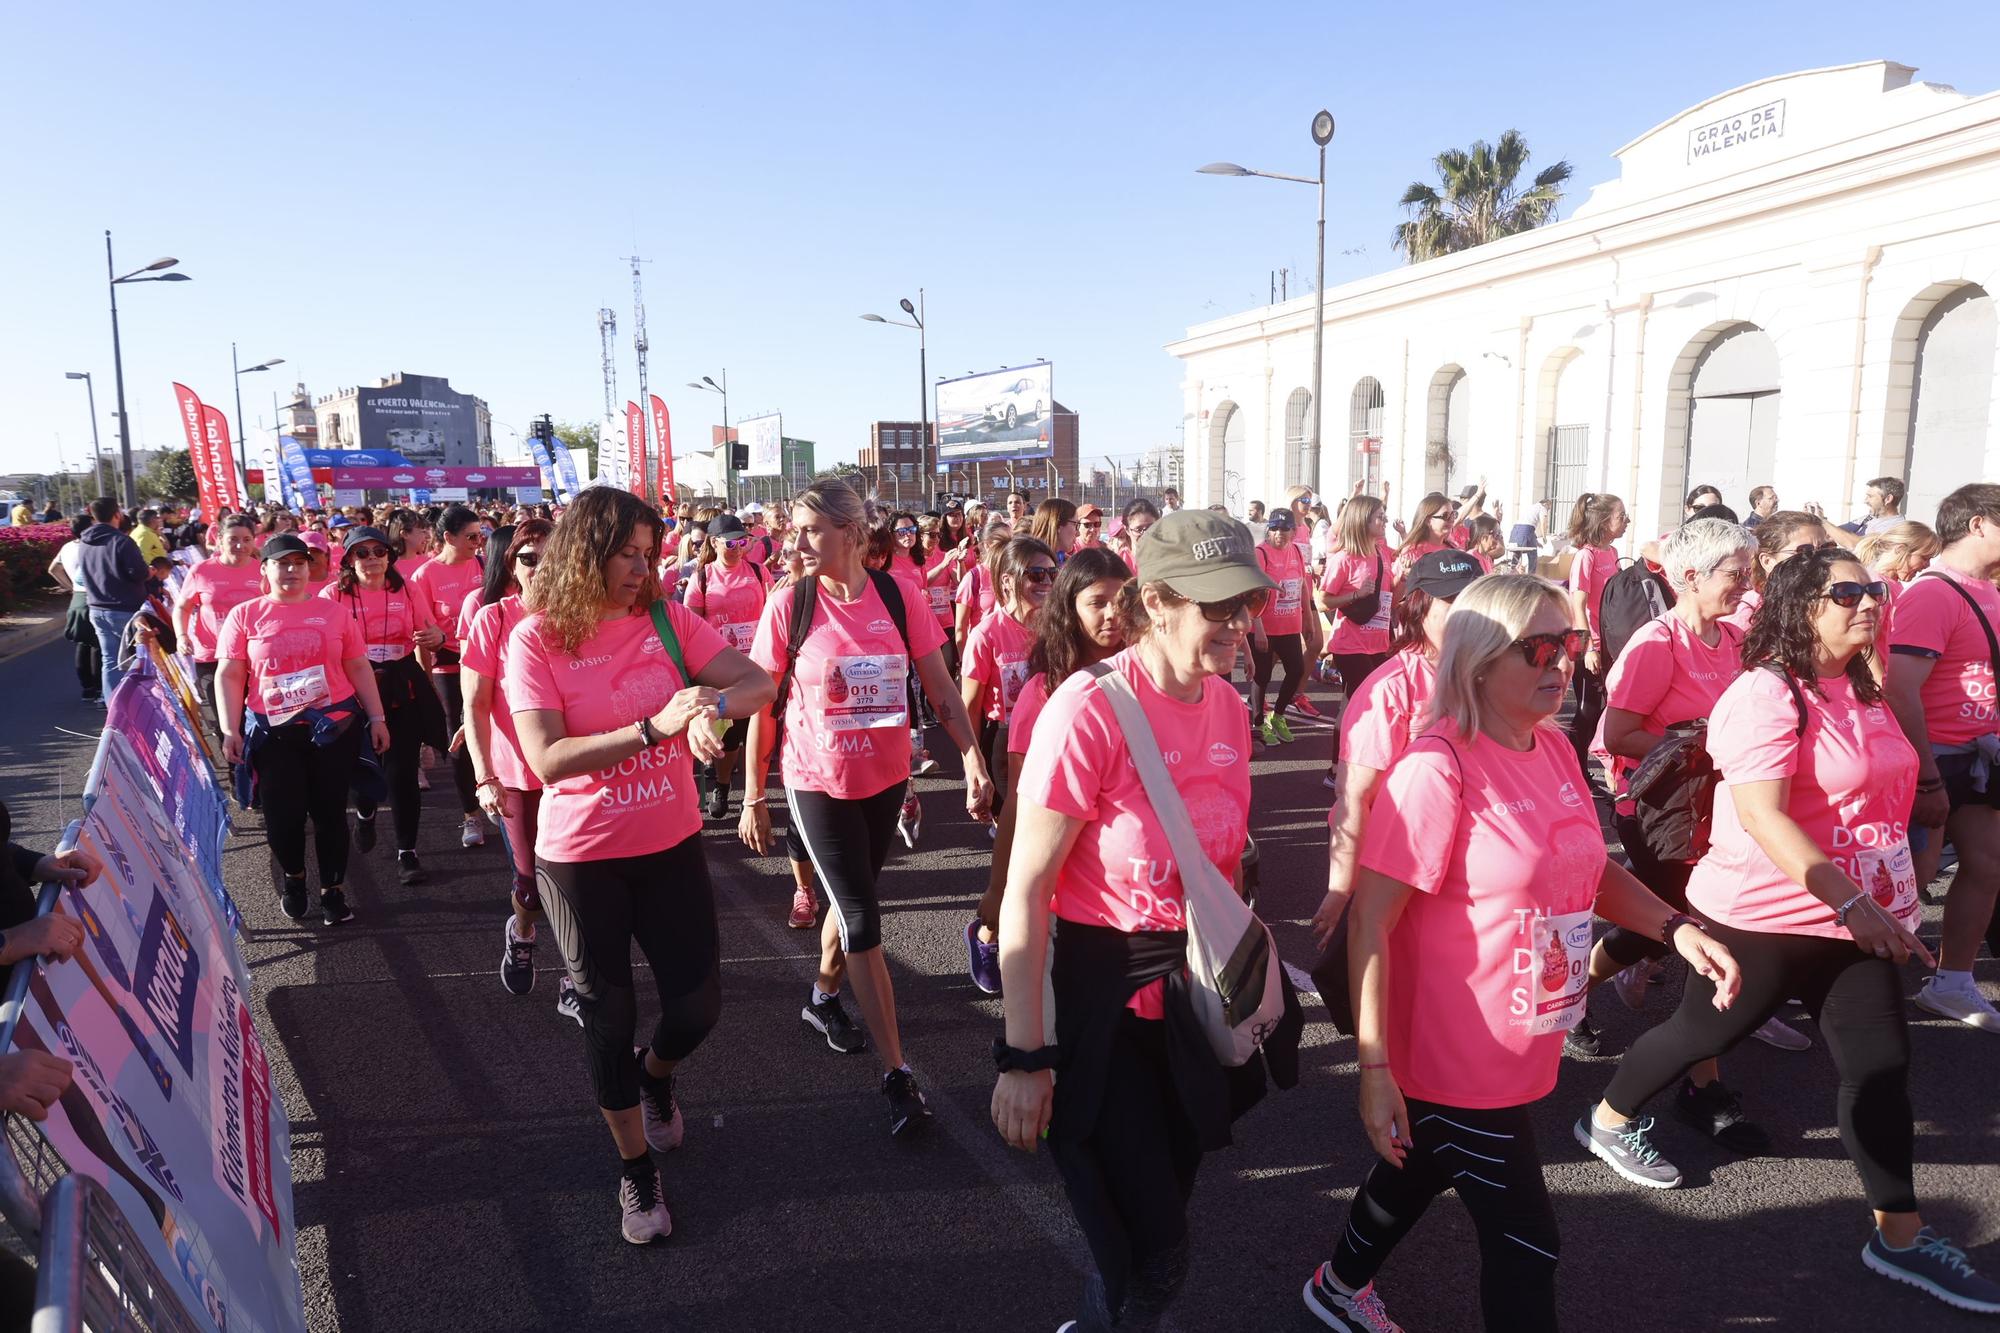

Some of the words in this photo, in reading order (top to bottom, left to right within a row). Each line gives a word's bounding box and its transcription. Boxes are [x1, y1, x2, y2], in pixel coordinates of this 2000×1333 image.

[1697, 119, 1742, 142] GRAO
[1751, 107, 1776, 126] DE
[1693, 122, 1777, 157] VALENCIA
[377, 398, 408, 408] PUERTO
[716, 613, 728, 623] TU
[569, 655, 612, 671] OYSHO
[285, 688, 307, 699] 016
[850, 684, 879, 696] 016
[856, 696, 874, 705] 3779
[1967, 681, 1996, 699] DO
[831, 717, 857, 726] OYSHO
[814, 732, 873, 752] SUMA
[600, 774, 674, 808] SUMA
[1832, 820, 1904, 849] DORS
[1128, 856, 1172, 887] TU
[1897, 873, 1915, 894] 016
[1130, 888, 1182, 921] DO
[1571, 954, 1589, 976] 01
[146, 910, 189, 1051] Norauto
[1546, 998, 1574, 1011] CARRERA
[1541, 1013, 1574, 1028] OYSHO
[223, 1057, 239, 1081] a
[218, 1076, 248, 1206] Kilómetro
[251, 1084, 274, 1218] avanzamos
